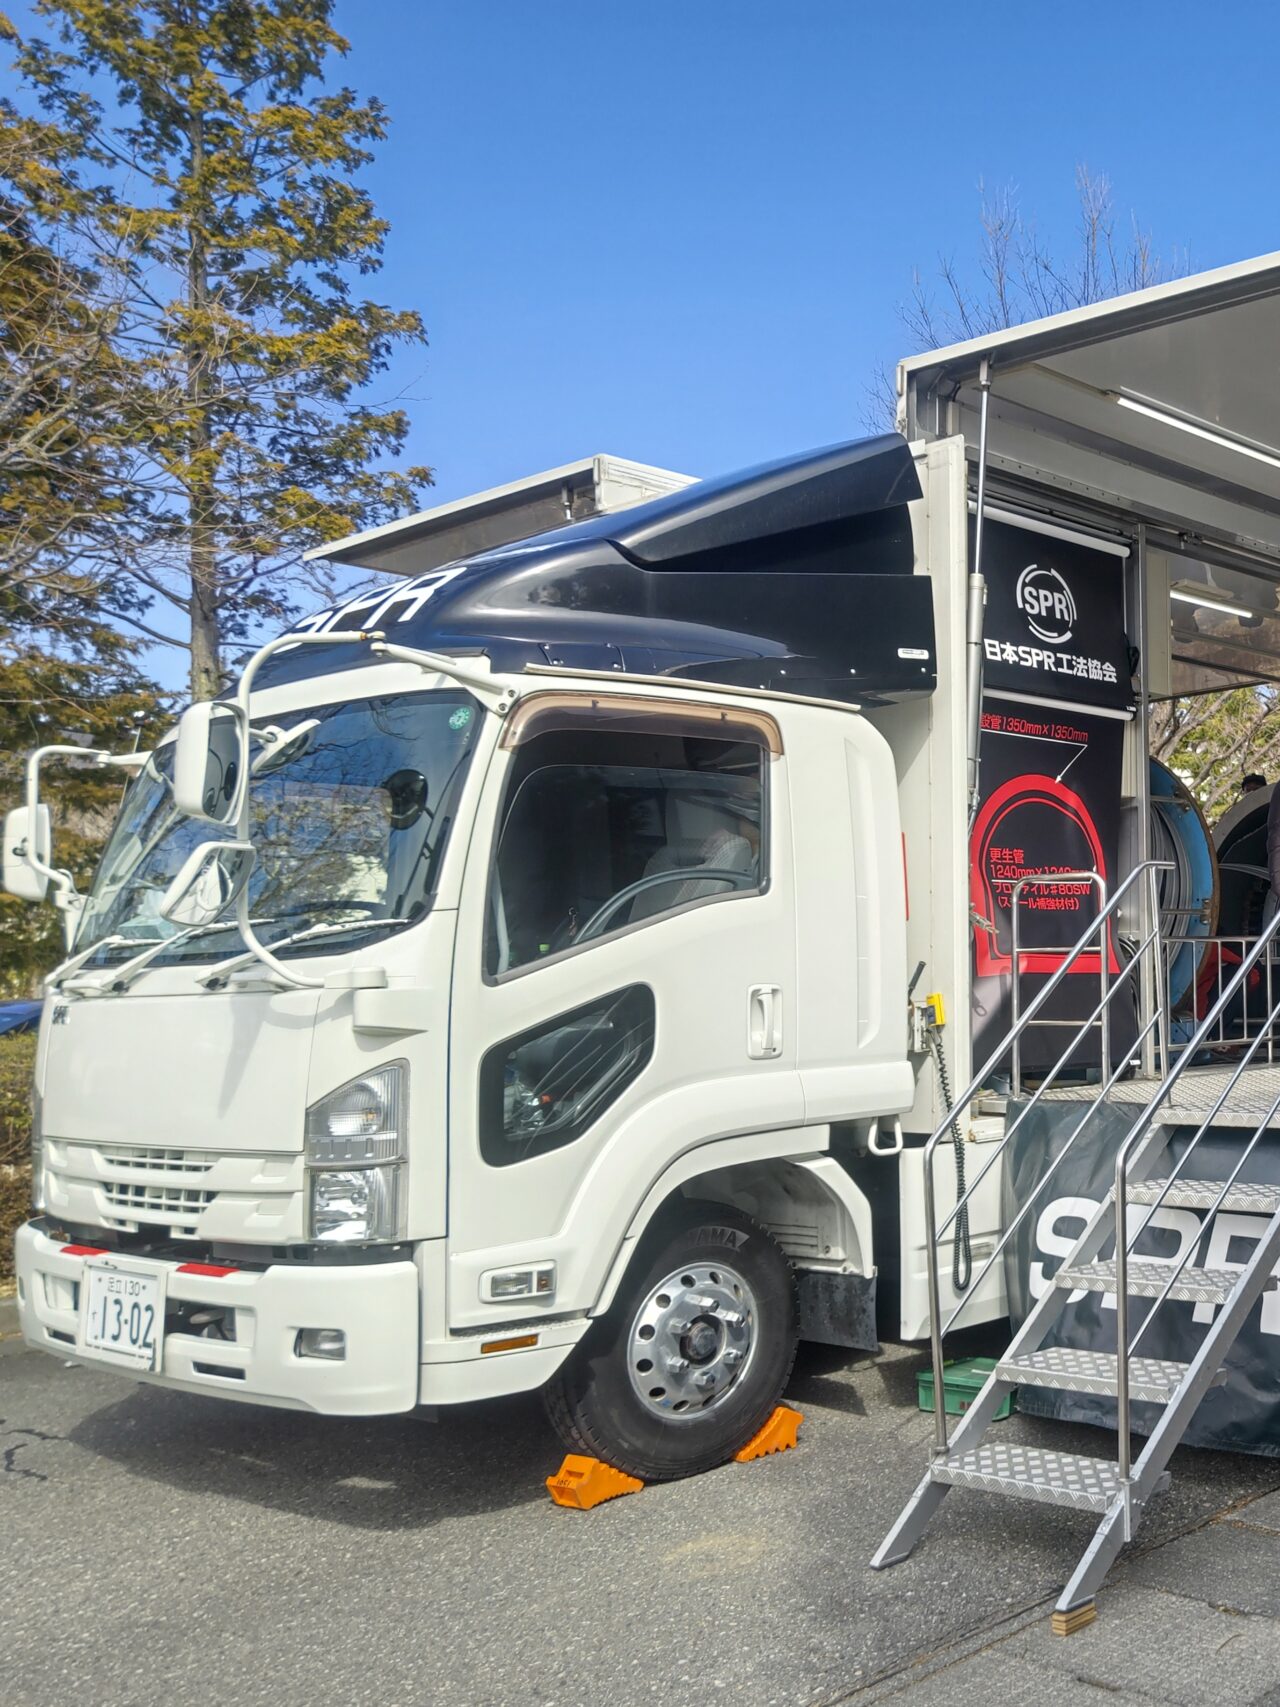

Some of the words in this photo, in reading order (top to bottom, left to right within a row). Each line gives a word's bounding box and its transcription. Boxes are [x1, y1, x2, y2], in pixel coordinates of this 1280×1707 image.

[1023, 586, 1070, 622] SPR
[983, 638, 1118, 683] 日本SPR工法協会
[989, 847, 1025, 864] 更生管
[998, 896, 1080, 911] (スール補強材付)
